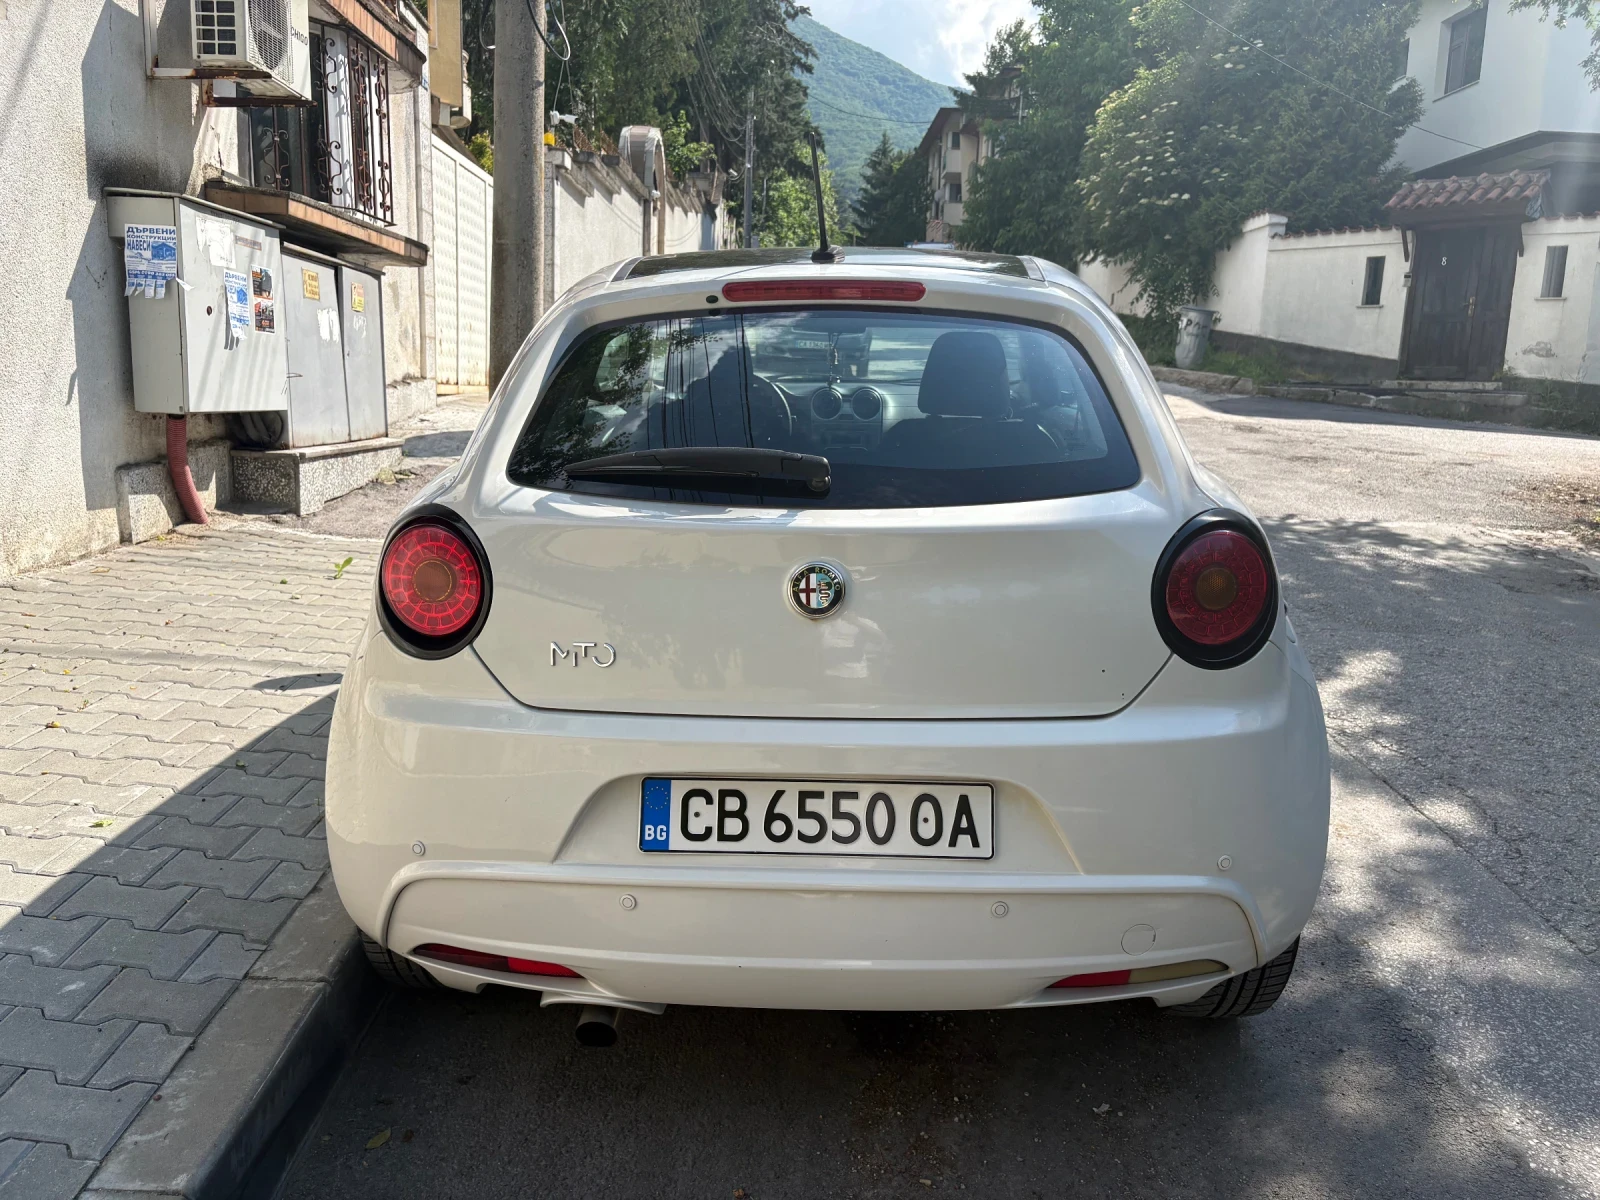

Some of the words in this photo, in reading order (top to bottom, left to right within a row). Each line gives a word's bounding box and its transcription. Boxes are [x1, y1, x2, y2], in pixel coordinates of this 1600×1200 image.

[126, 226, 176, 236] ДЪРВЕНИ
[126, 239, 151, 251] НАВЕСИ
[1441, 256, 1447, 266] 8
[792, 570, 809, 592] ALFA
[815, 567, 841, 591] ROMEO
[680, 788, 749, 842] CB
[763, 789, 895, 846] 6550
[910, 793, 980, 848] OA
[644, 824, 667, 840] BG
